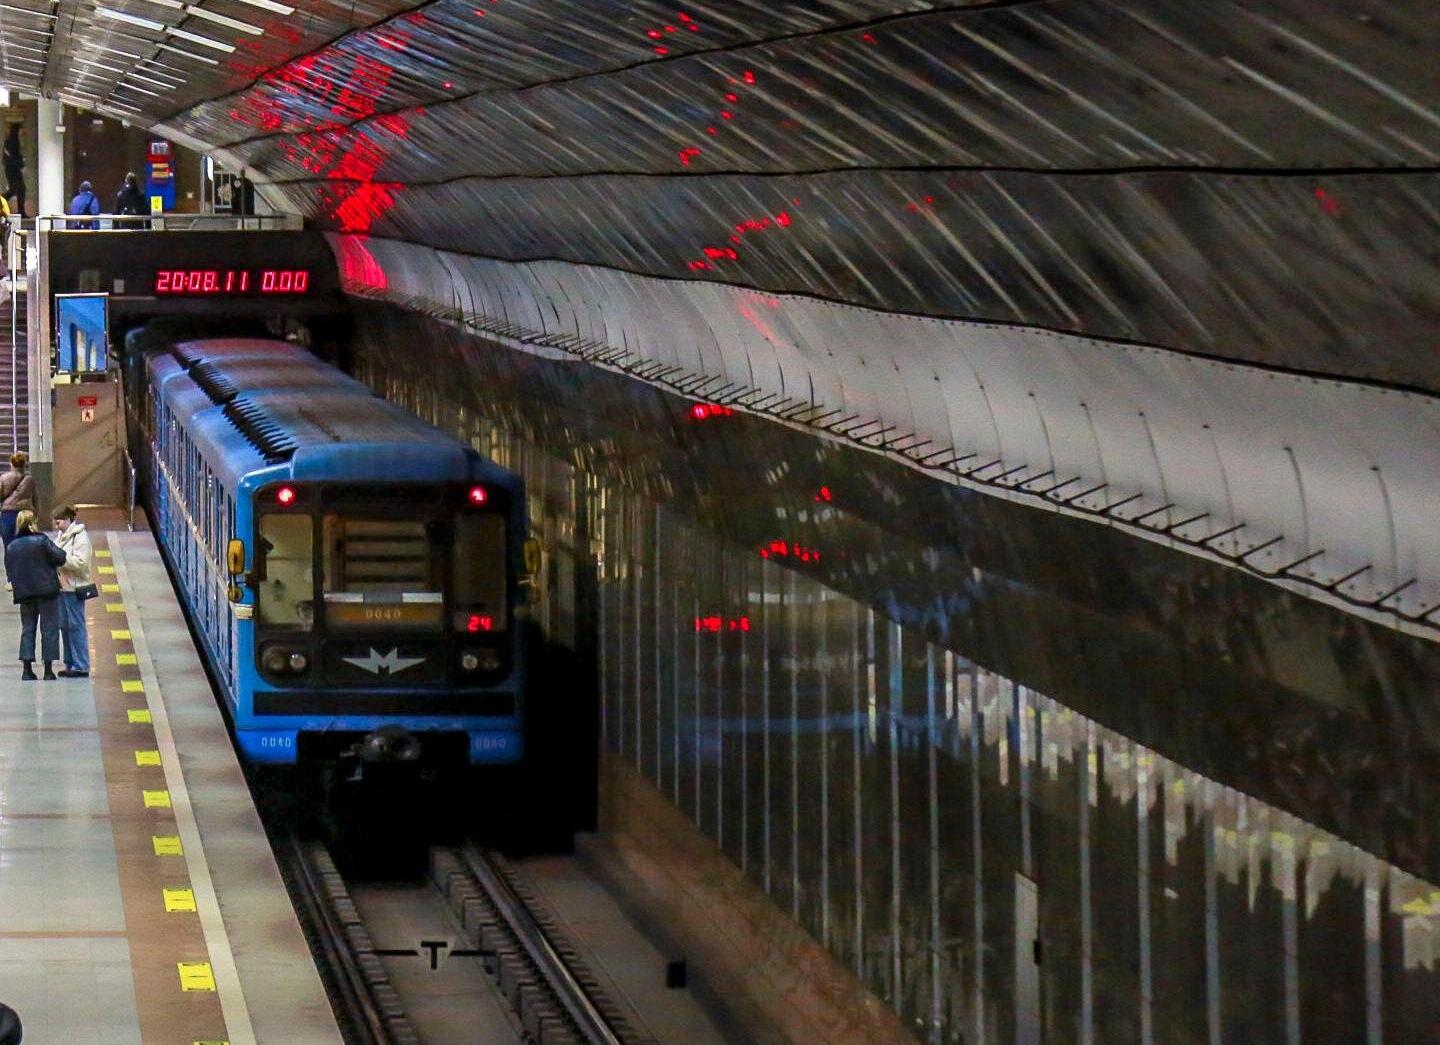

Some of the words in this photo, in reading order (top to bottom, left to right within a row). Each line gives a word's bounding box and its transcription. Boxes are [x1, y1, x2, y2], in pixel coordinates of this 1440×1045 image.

[263, 271, 308, 291] 0.00
[366, 608, 401, 620] 0040
[467, 615, 493, 632] 24
[261, 737, 292, 748] 0040
